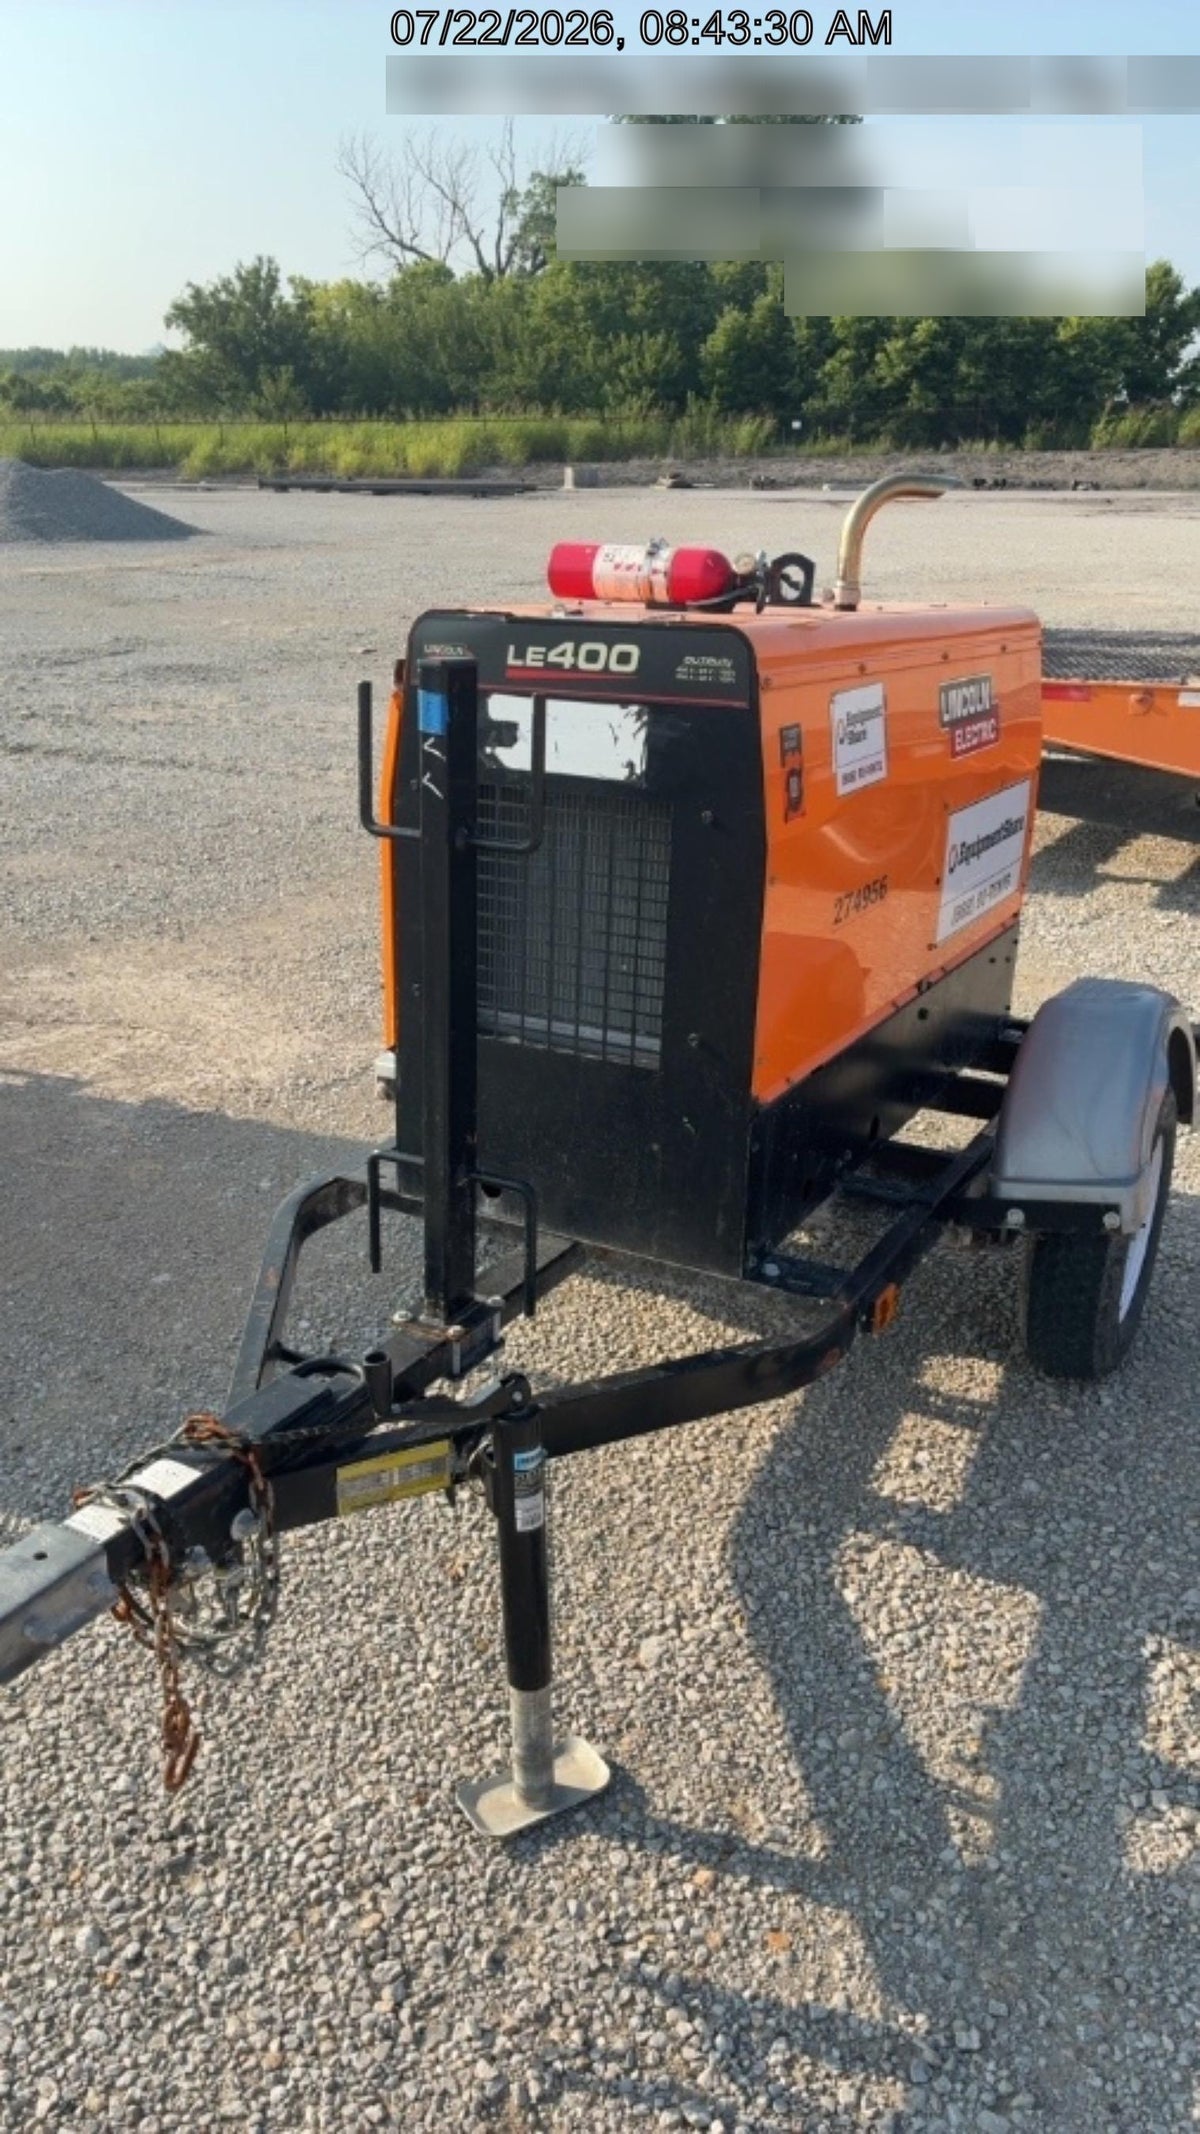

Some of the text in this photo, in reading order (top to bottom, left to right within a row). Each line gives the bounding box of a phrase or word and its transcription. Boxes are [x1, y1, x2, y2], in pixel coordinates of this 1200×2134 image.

[506, 642, 640, 672] LE400
[942, 681, 991, 722] LINCOLN
[956, 718, 997, 752] ELECTRIC
[959, 815, 1025, 866] EquipmentShare
[832, 874, 889, 926] 274956
